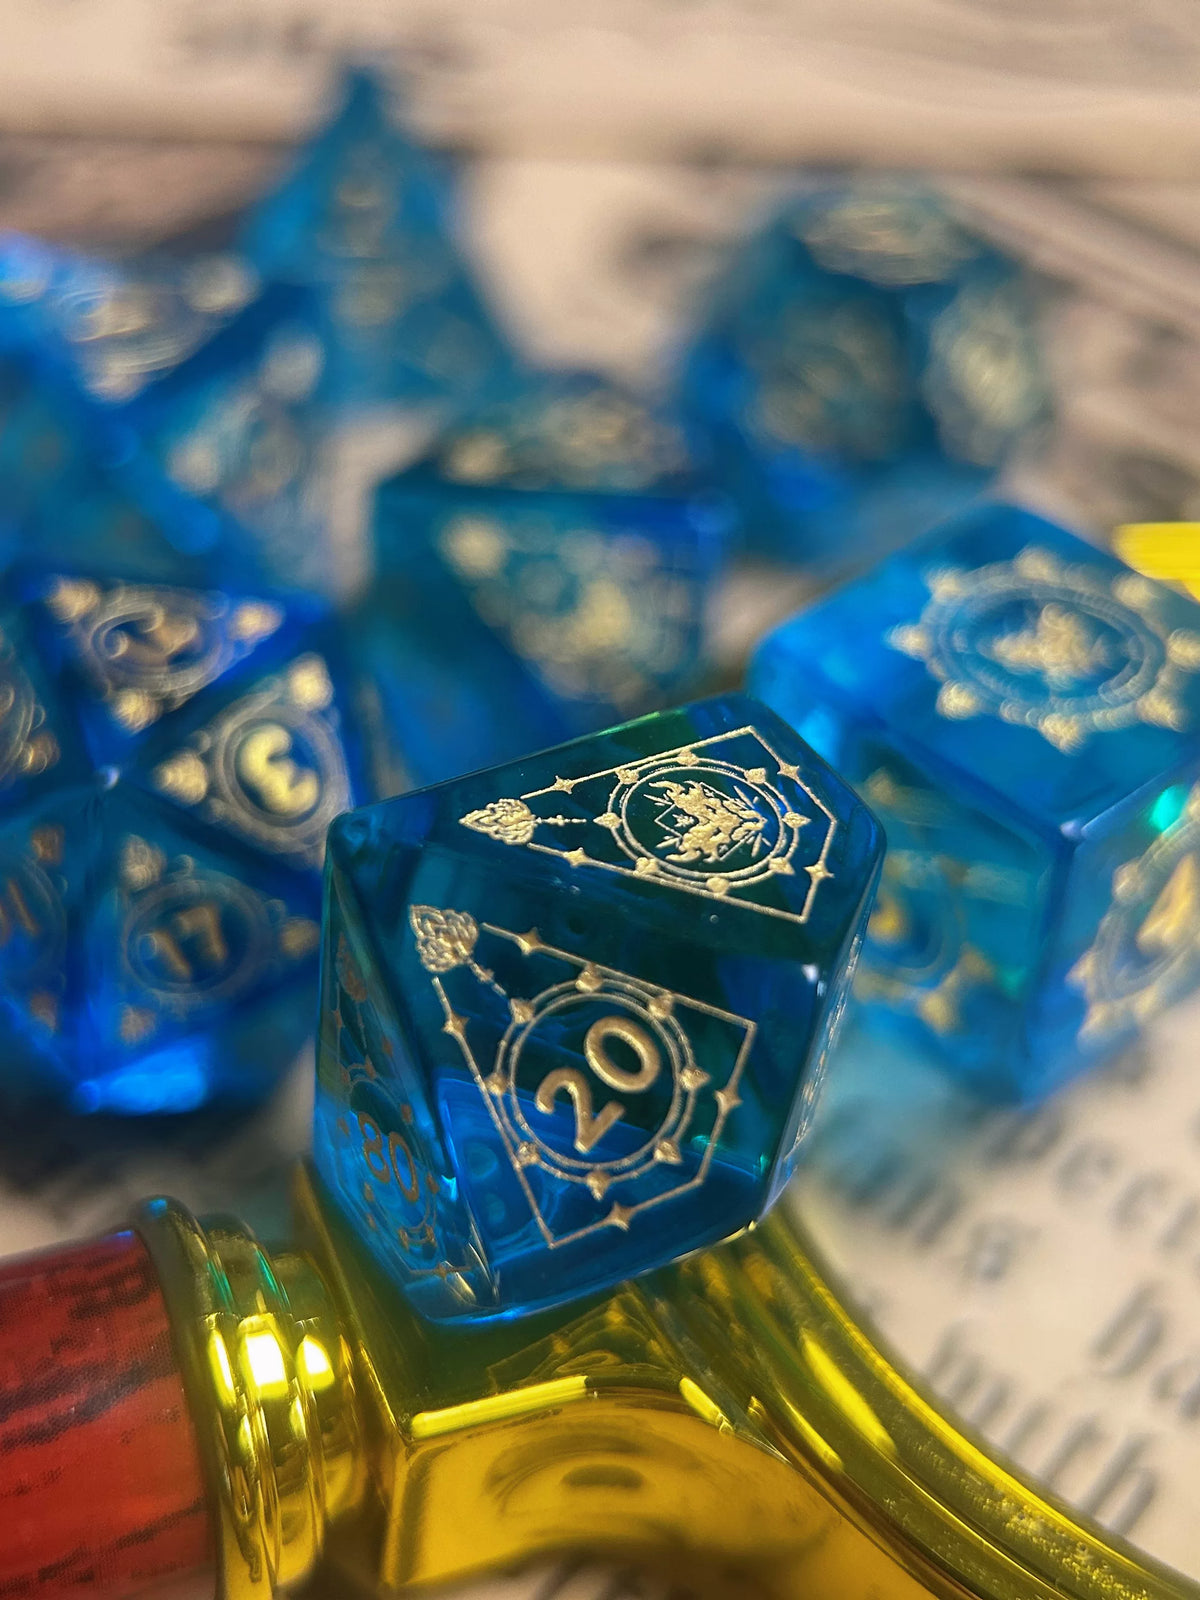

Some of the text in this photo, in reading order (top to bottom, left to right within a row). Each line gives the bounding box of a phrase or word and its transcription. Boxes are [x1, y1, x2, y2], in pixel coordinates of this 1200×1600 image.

[240, 723, 319, 815] 3
[142, 905, 228, 979] 17
[535, 1016, 660, 1153] 20
[357, 1110, 420, 1203] 80
